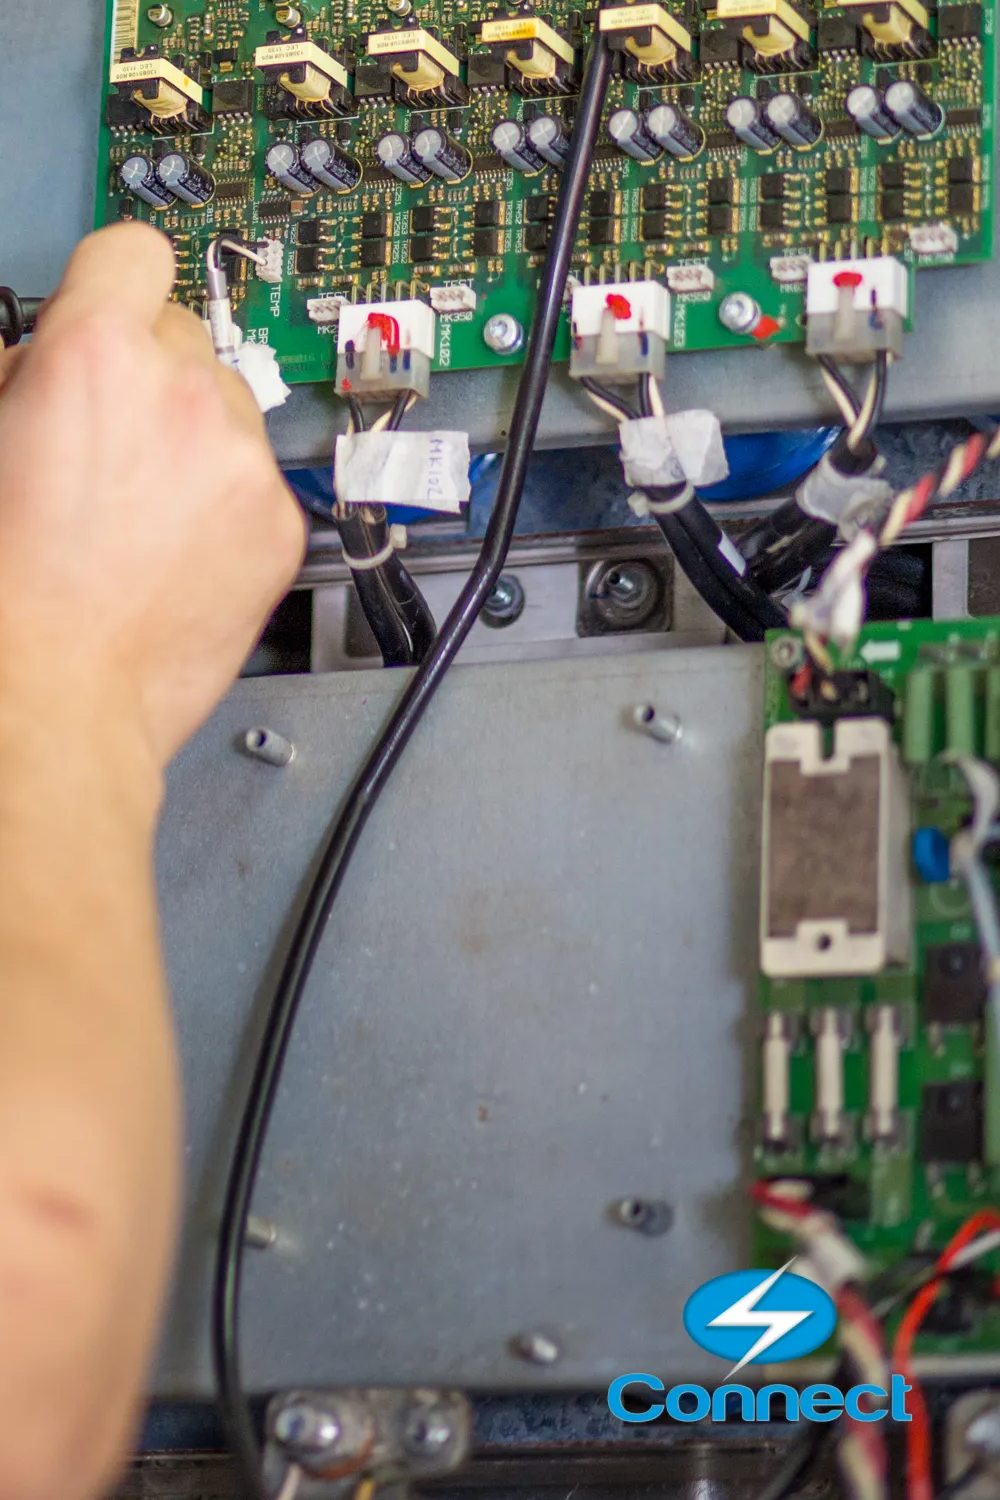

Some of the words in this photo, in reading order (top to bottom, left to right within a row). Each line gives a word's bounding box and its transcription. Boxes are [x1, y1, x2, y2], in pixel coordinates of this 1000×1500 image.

[443, 278, 474, 289] TEST
[270, 284, 281, 318] TEMP
[440, 312, 473, 323] MK350
[674, 303, 686, 349] MK103
[439, 325, 451, 367] MK102
